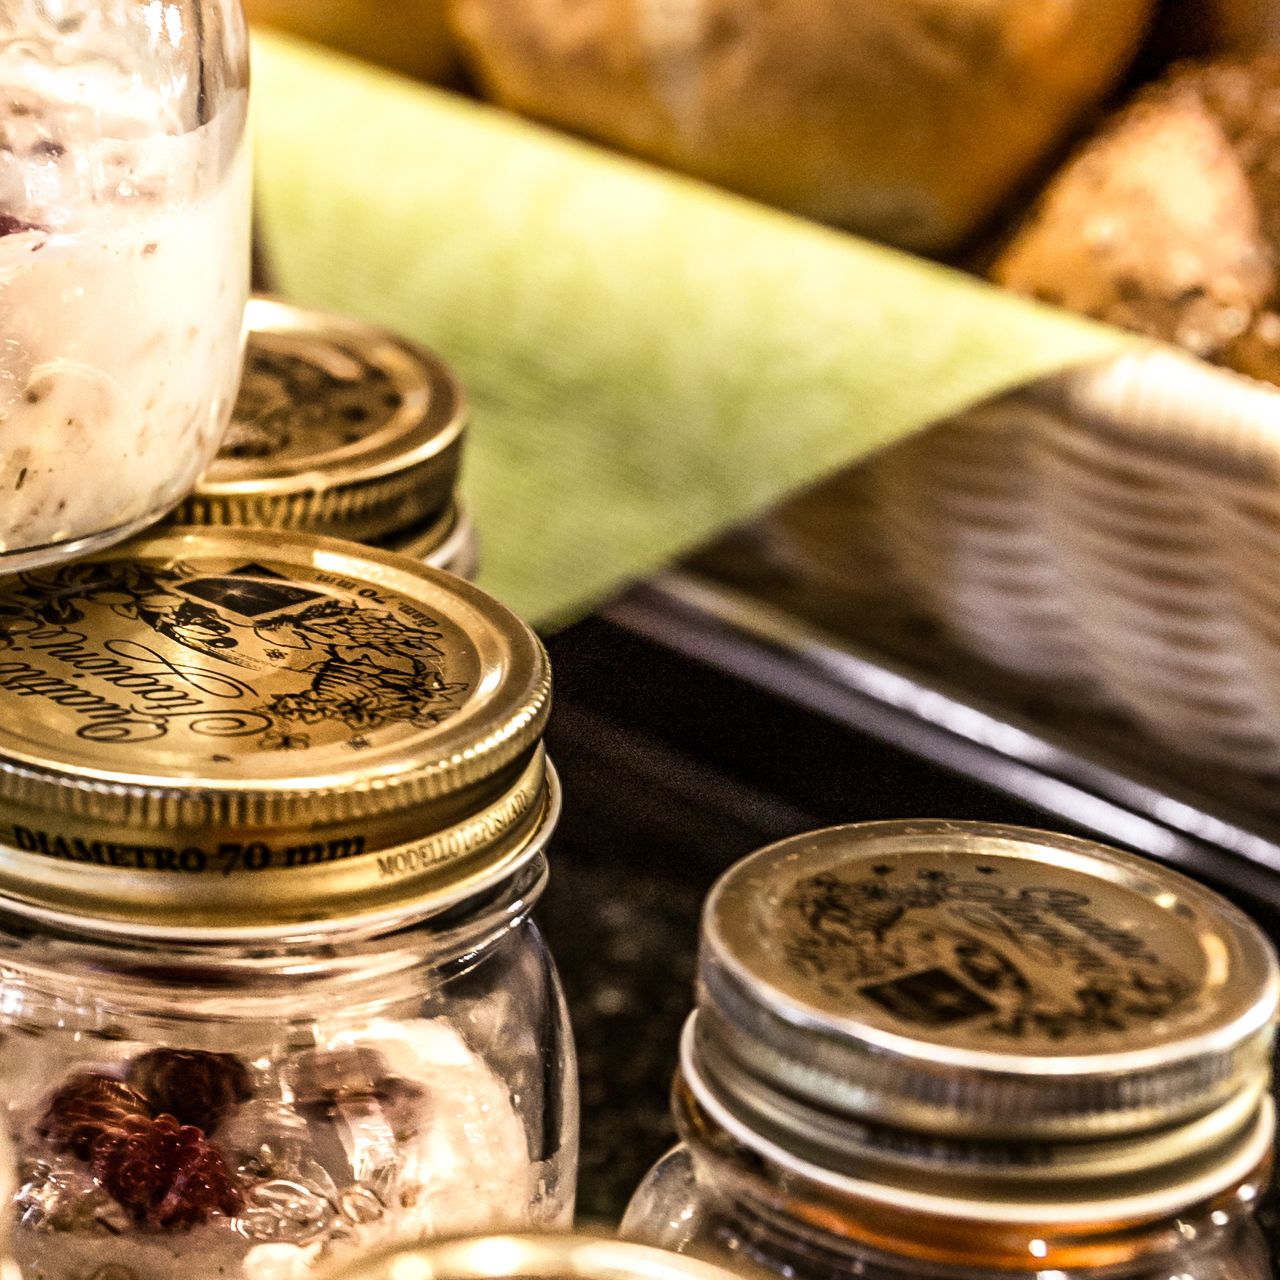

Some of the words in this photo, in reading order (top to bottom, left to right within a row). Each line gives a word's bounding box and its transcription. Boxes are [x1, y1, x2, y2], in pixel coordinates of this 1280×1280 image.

[12, 825, 207, 872] DIAMETRO
[216, 840, 270, 876] 70
[286, 835, 367, 868] mm
